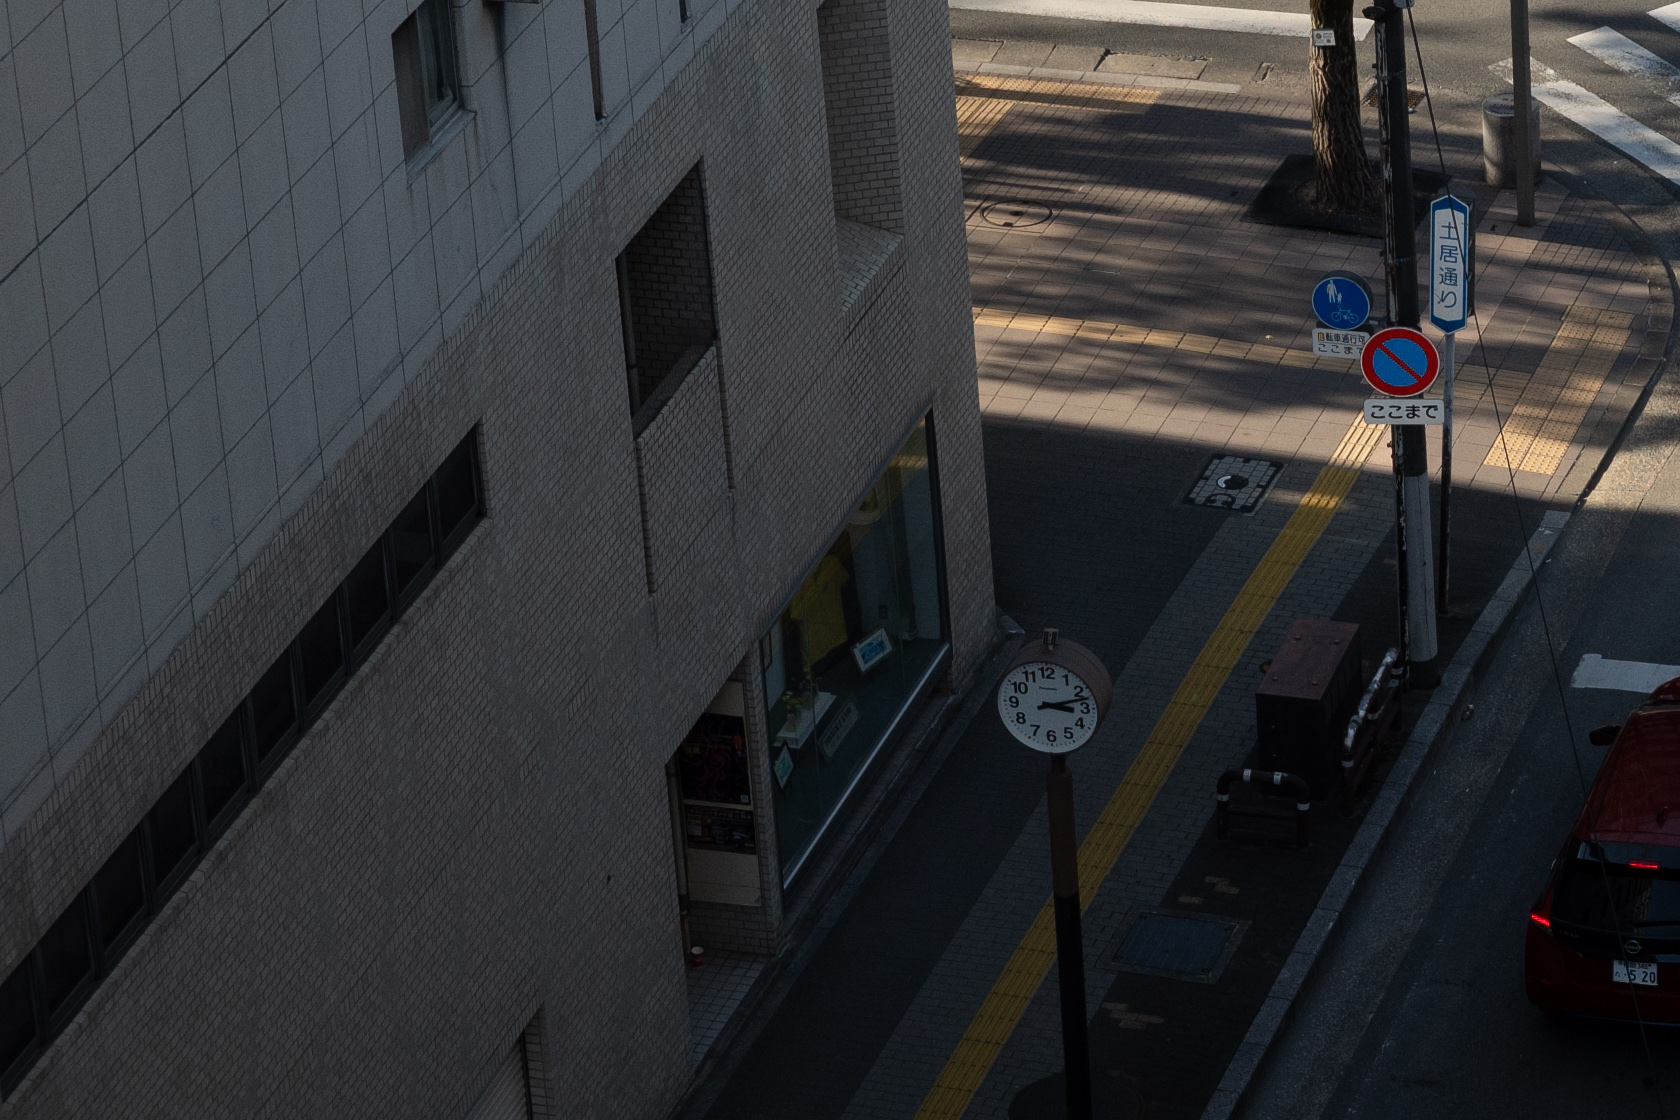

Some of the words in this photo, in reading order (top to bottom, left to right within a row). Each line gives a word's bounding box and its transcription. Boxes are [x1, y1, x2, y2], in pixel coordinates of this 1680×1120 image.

[1439, 221, 1459, 308] 土居通り
[1317, 332, 1366, 345] 自転車通行可
[1371, 404, 1439, 419] ここまで
[1022, 670, 1036, 683] 11
[1038, 666, 1055, 679] 12
[1062, 673, 1069, 686] 1
[1011, 681, 1028, 694] 10
[1074, 685, 1085, 697] 2
[1008, 696, 1019, 708] 9
[1080, 702, 1090, 714] 3
[1016, 712, 1026, 724] 8
[1074, 717, 1085, 729] 4
[1030, 724, 1041, 736] 7
[1046, 730, 1057, 742] 6
[1063, 727, 1074, 739] 5
